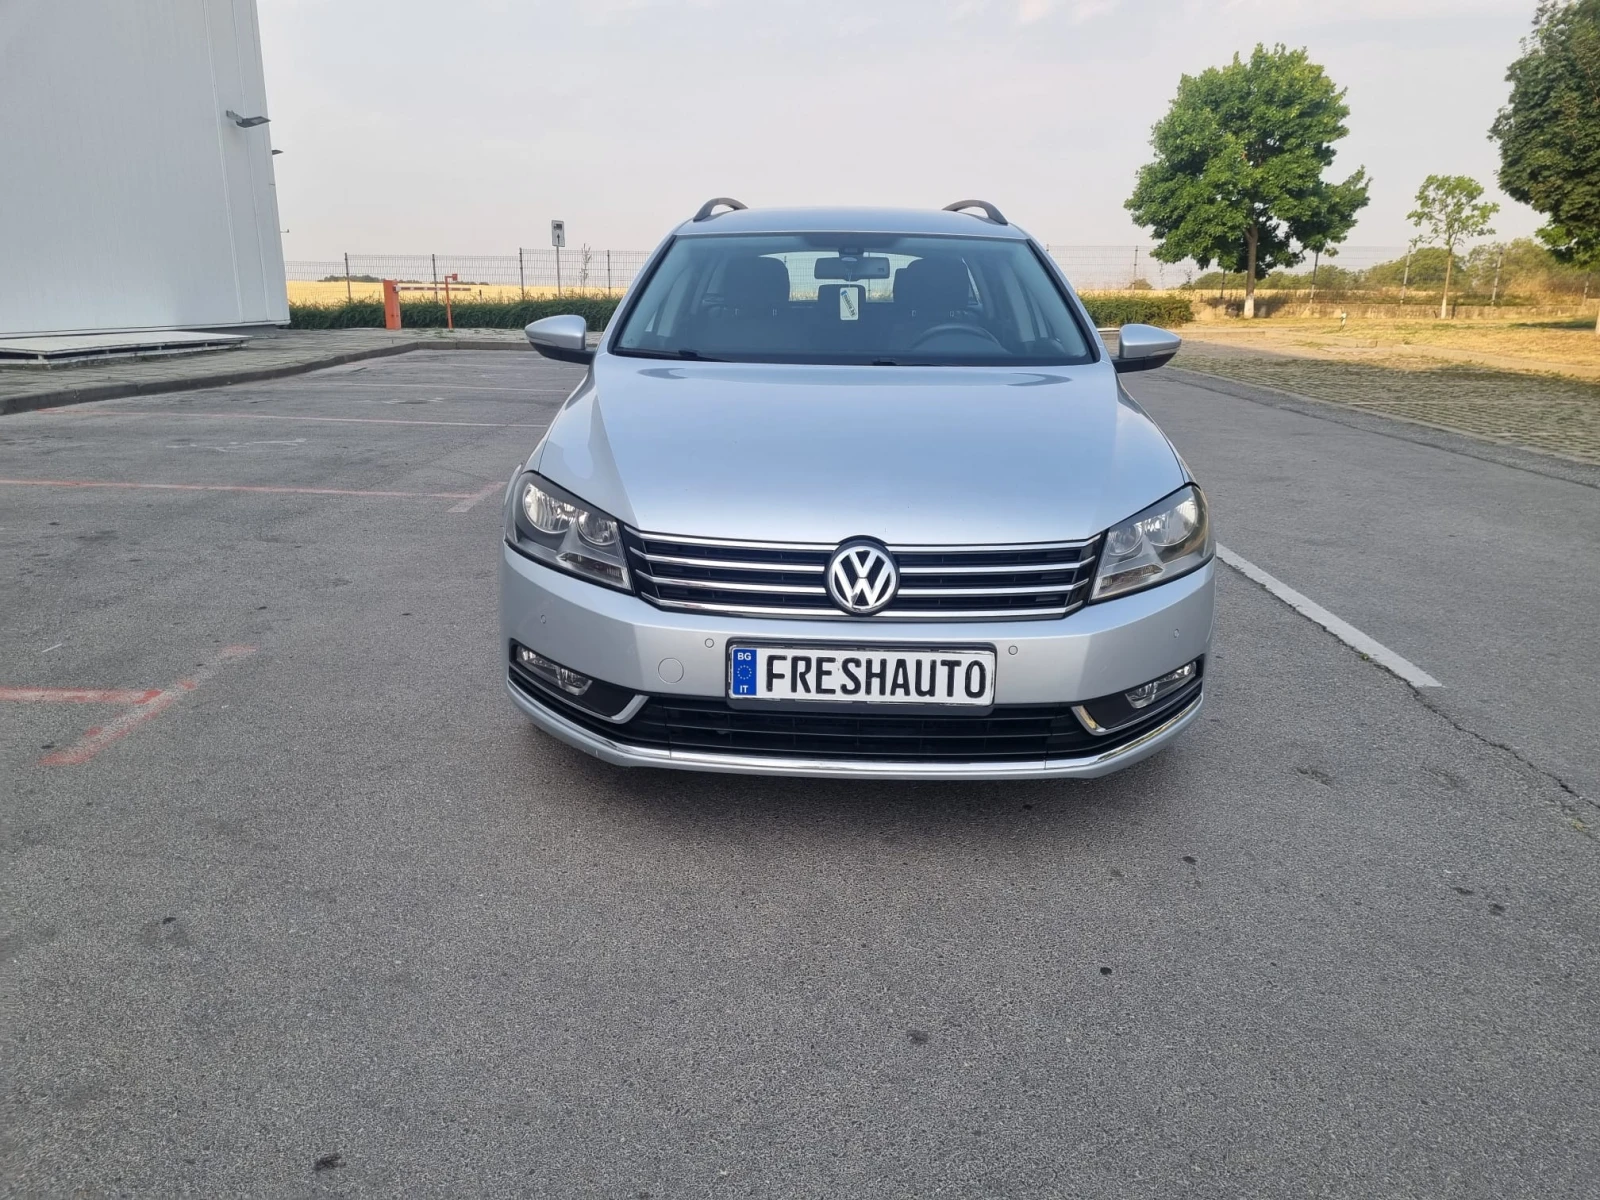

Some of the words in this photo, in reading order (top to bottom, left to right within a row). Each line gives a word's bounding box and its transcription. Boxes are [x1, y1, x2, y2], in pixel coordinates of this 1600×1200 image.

[829, 546, 895, 611] VW
[737, 652, 752, 661] BG
[739, 685, 749, 693] IT
[766, 655, 987, 699] FRESHAUTO
